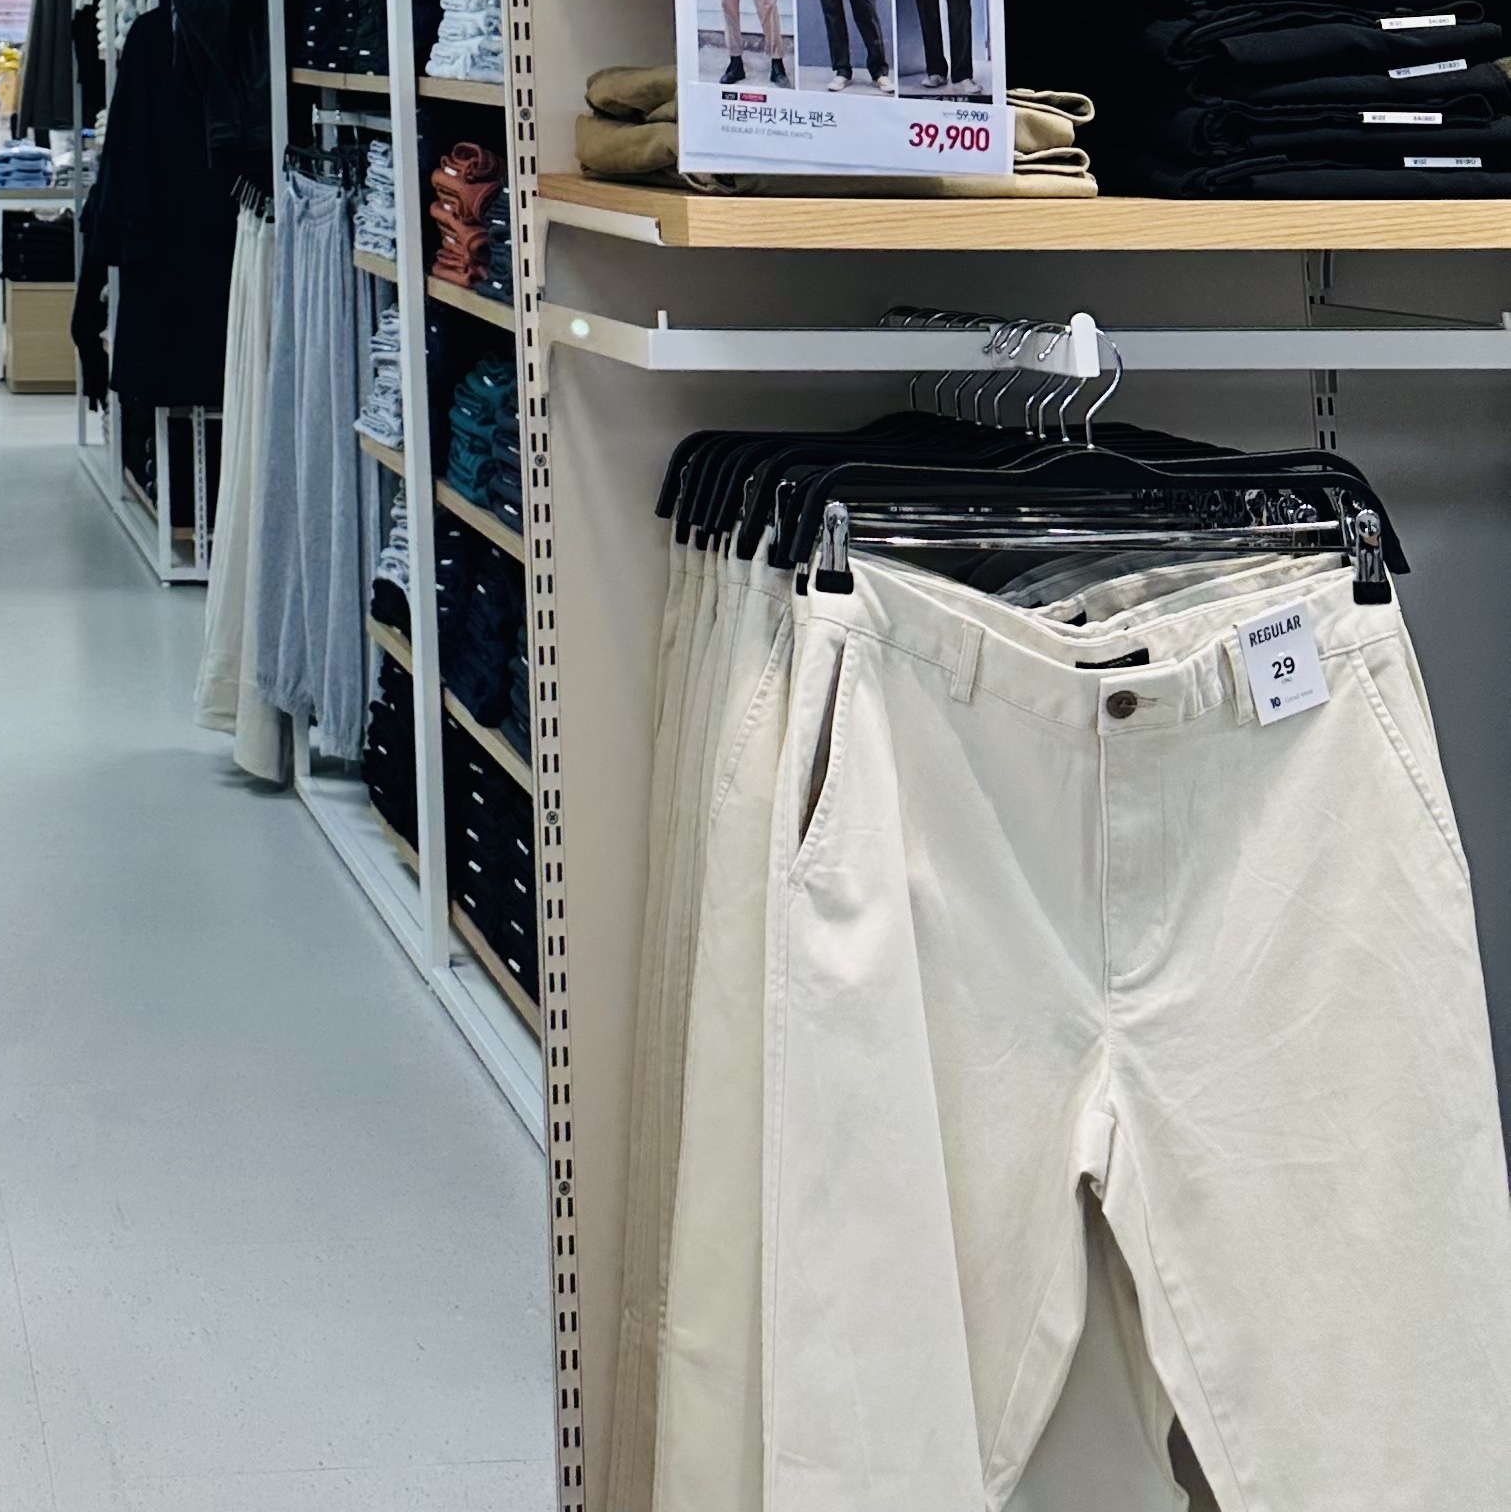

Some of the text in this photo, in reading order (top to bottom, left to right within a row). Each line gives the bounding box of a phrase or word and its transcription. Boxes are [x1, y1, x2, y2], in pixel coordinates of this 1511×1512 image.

[721, 104, 838, 128] 레귤러핏 치노 팬츠
[908, 122, 990, 154] 39,900
[1248, 614, 1302, 648] REGULAR
[1271, 656, 1296, 679] 29
